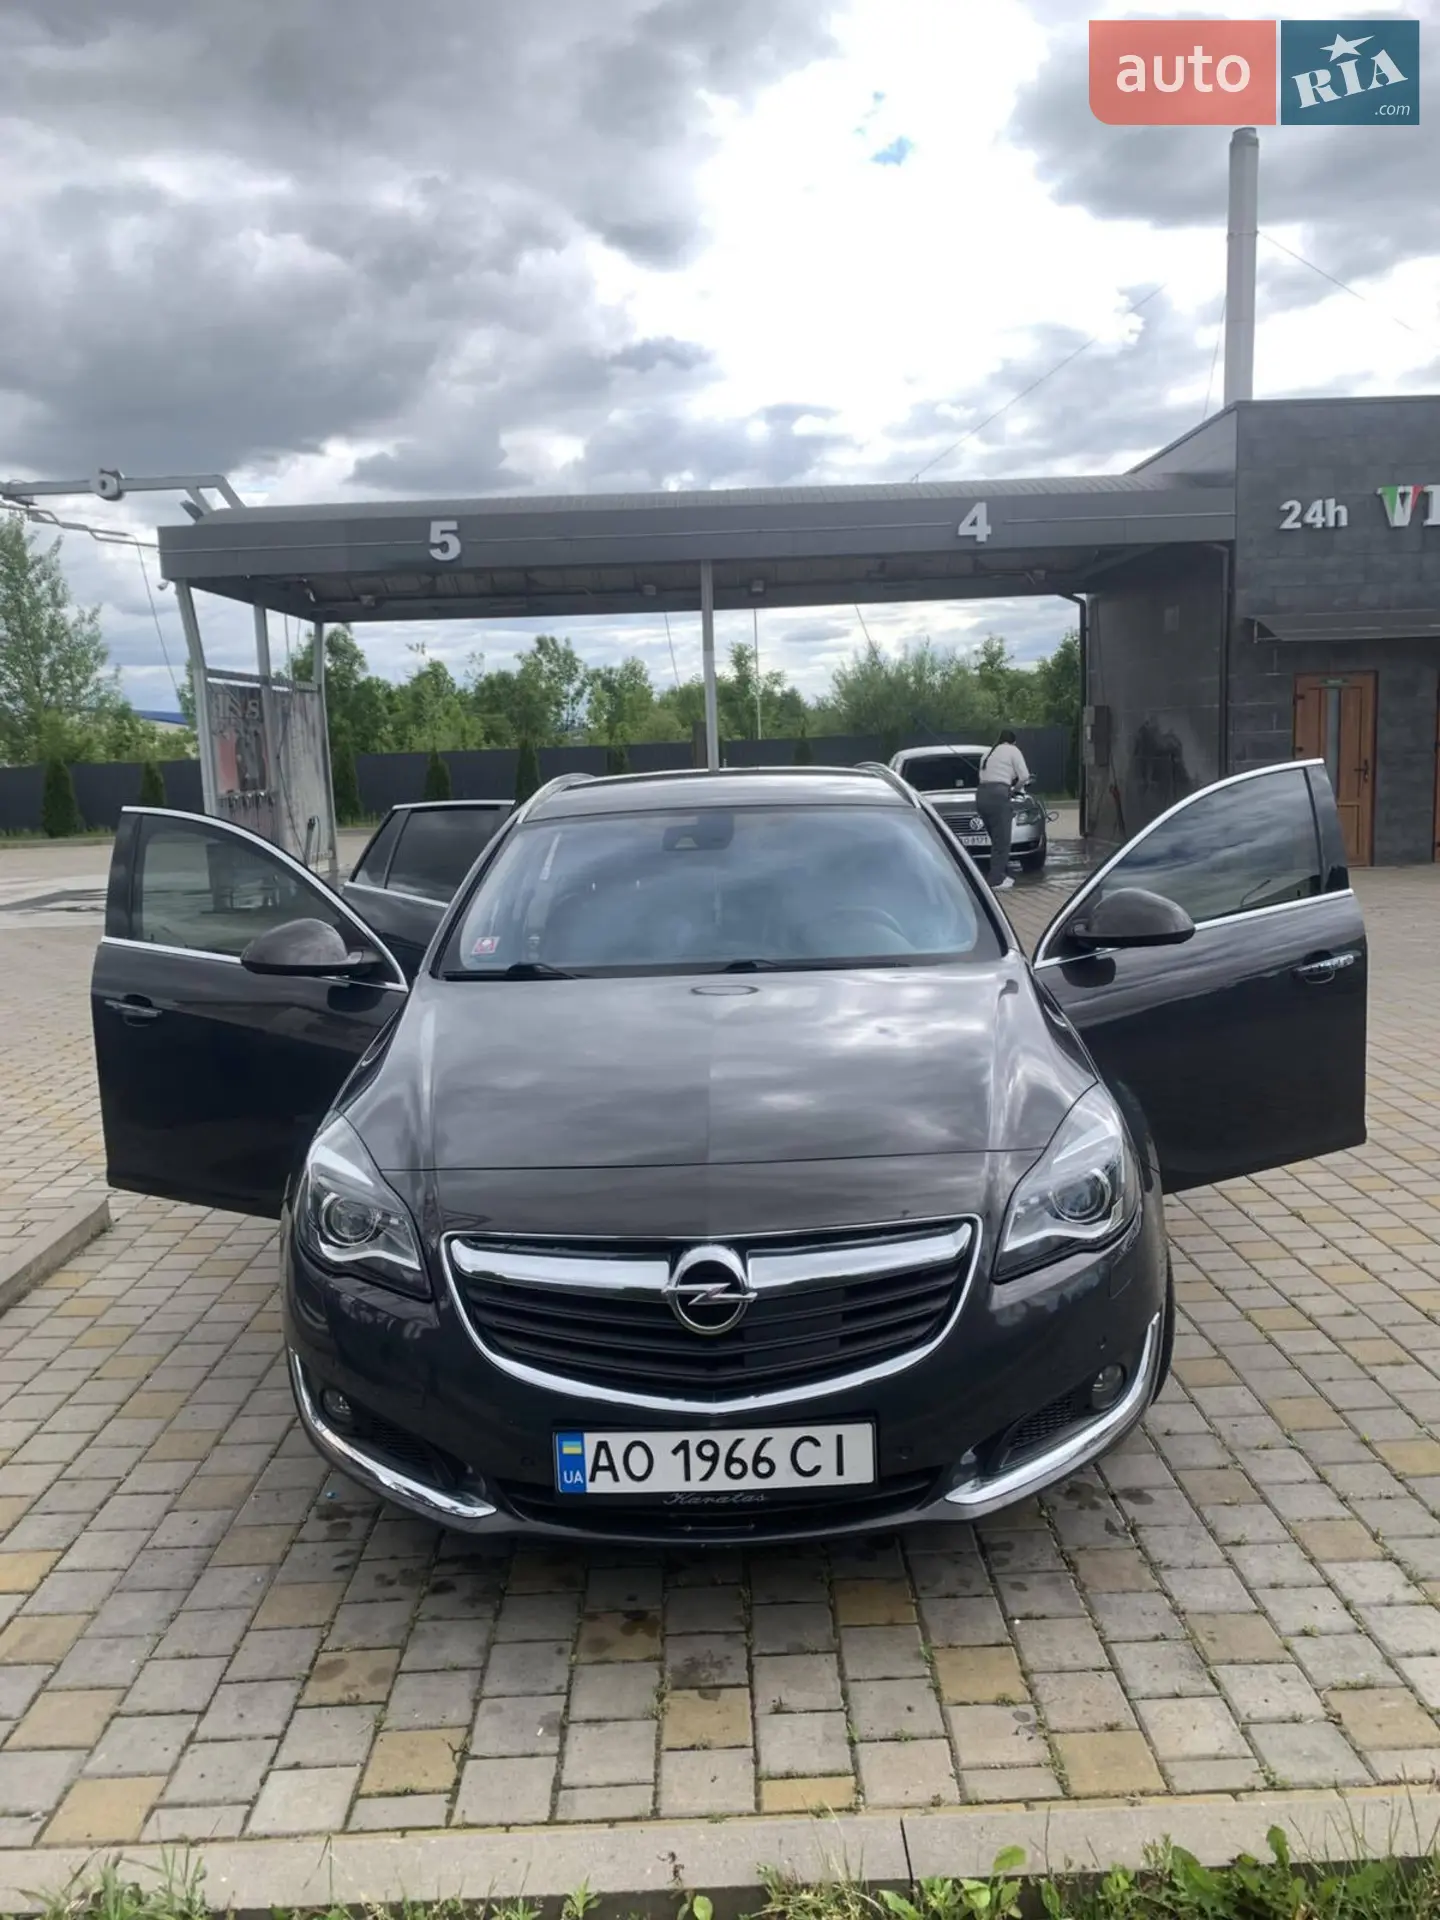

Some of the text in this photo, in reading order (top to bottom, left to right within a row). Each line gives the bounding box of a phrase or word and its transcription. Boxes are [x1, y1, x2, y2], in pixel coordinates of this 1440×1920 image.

[958, 501, 991, 542] 4
[1279, 498, 1349, 530] 24h
[429, 520, 461, 561] 5
[563, 1470, 584, 1484] UA
[588, 1433, 845, 1483] AO 1966 CI
